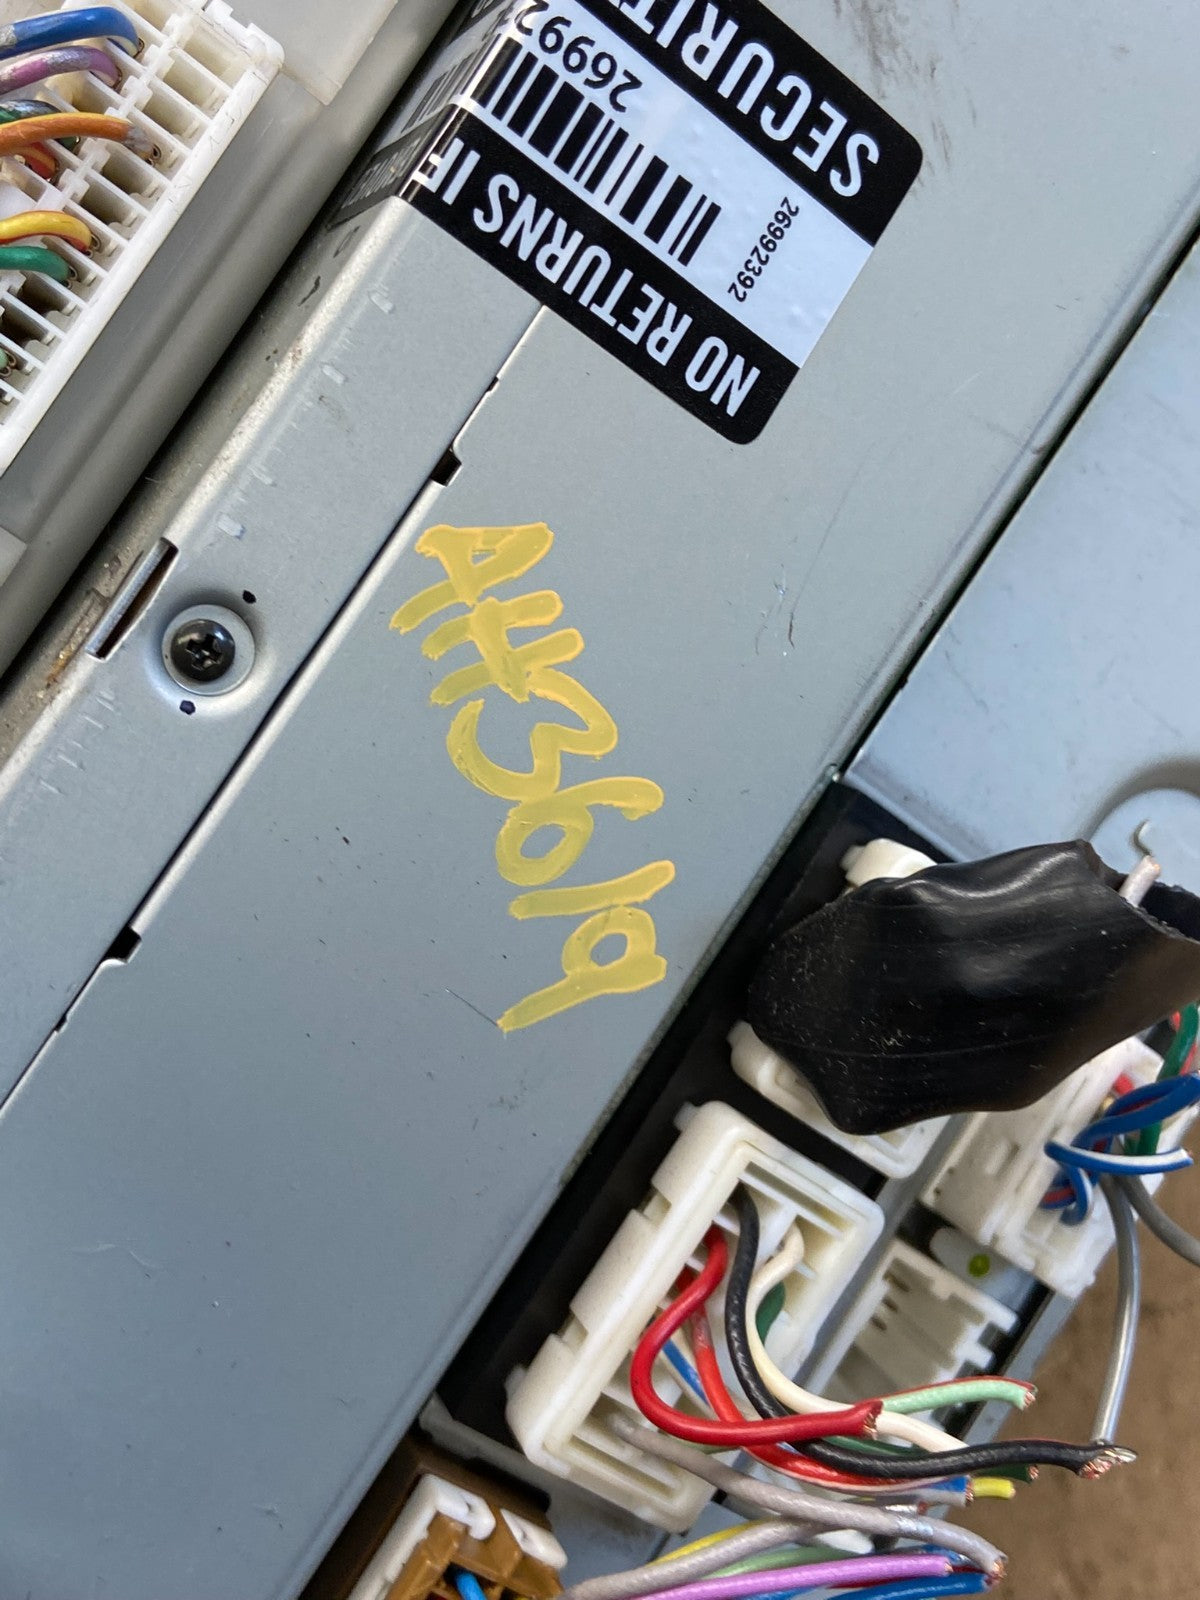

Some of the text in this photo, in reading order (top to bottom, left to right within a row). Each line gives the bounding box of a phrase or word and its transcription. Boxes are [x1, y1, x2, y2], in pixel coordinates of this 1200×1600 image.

[608, 0, 880, 198] SECURIT
[411, 137, 481, 206] IF
[473, 173, 693, 366] RETURNS
[728, 196, 799, 303] 26992392
[686, 336, 760, 417] NO
